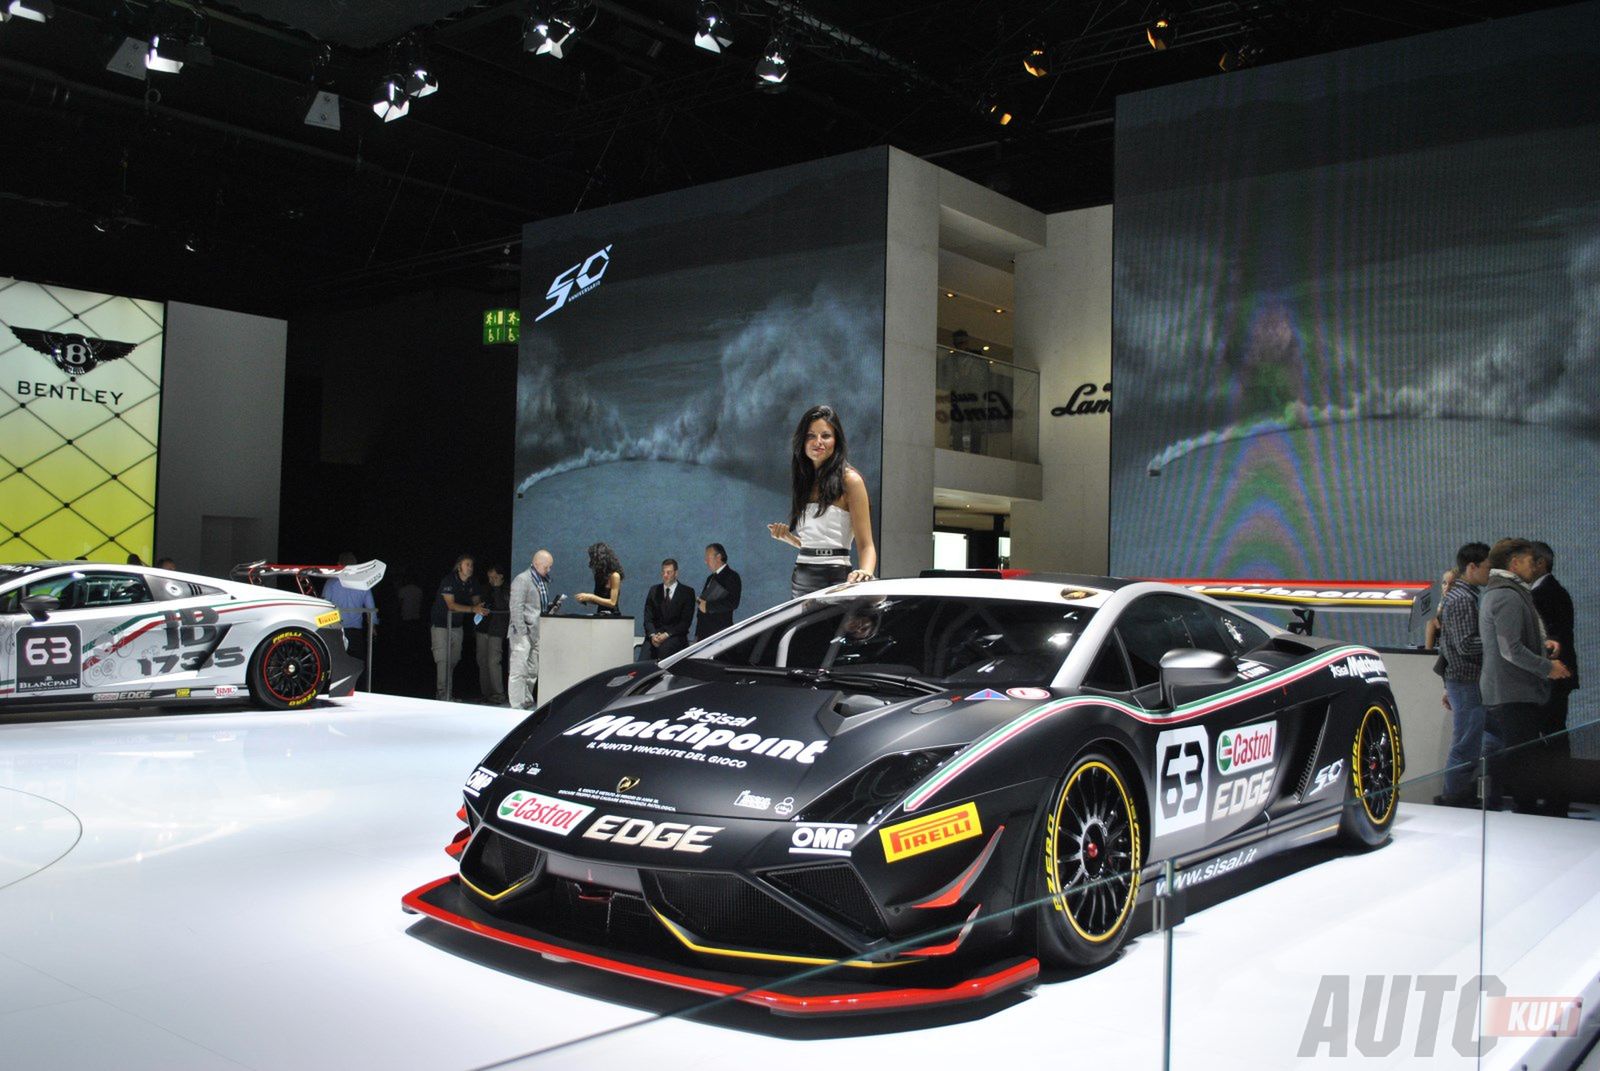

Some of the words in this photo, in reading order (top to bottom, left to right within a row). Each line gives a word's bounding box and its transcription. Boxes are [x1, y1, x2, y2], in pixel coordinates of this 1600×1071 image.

[18, 381, 123, 405] BENTLEY
[25, 637, 72, 666] 63
[272, 632, 302, 644] PIRELLI
[137, 647, 246, 676] 1735
[19, 678, 78, 689] BLANCPAIN
[119, 690, 153, 700] EDGE
[700, 712, 757, 728] Sisal
[563, 715, 828, 764] Matchpoint
[1233, 726, 1273, 767] Castrol
[586, 741, 596, 749] IL
[596, 742, 633, 752] PUNTO
[632, 744, 686, 758] VINCENTE
[684, 751, 707, 762] DEL
[708, 755, 748, 769] GIOCO
[466, 770, 493, 791] OMP
[1160, 740, 1205, 820] 63
[1211, 766, 1277, 821] EDGE
[514, 798, 583, 830] Castrol
[582, 814, 726, 853] EDGE
[792, 827, 856, 849] OMP
[890, 810, 972, 854] PIRELLI
[1045, 813, 1057, 893] ZERO
